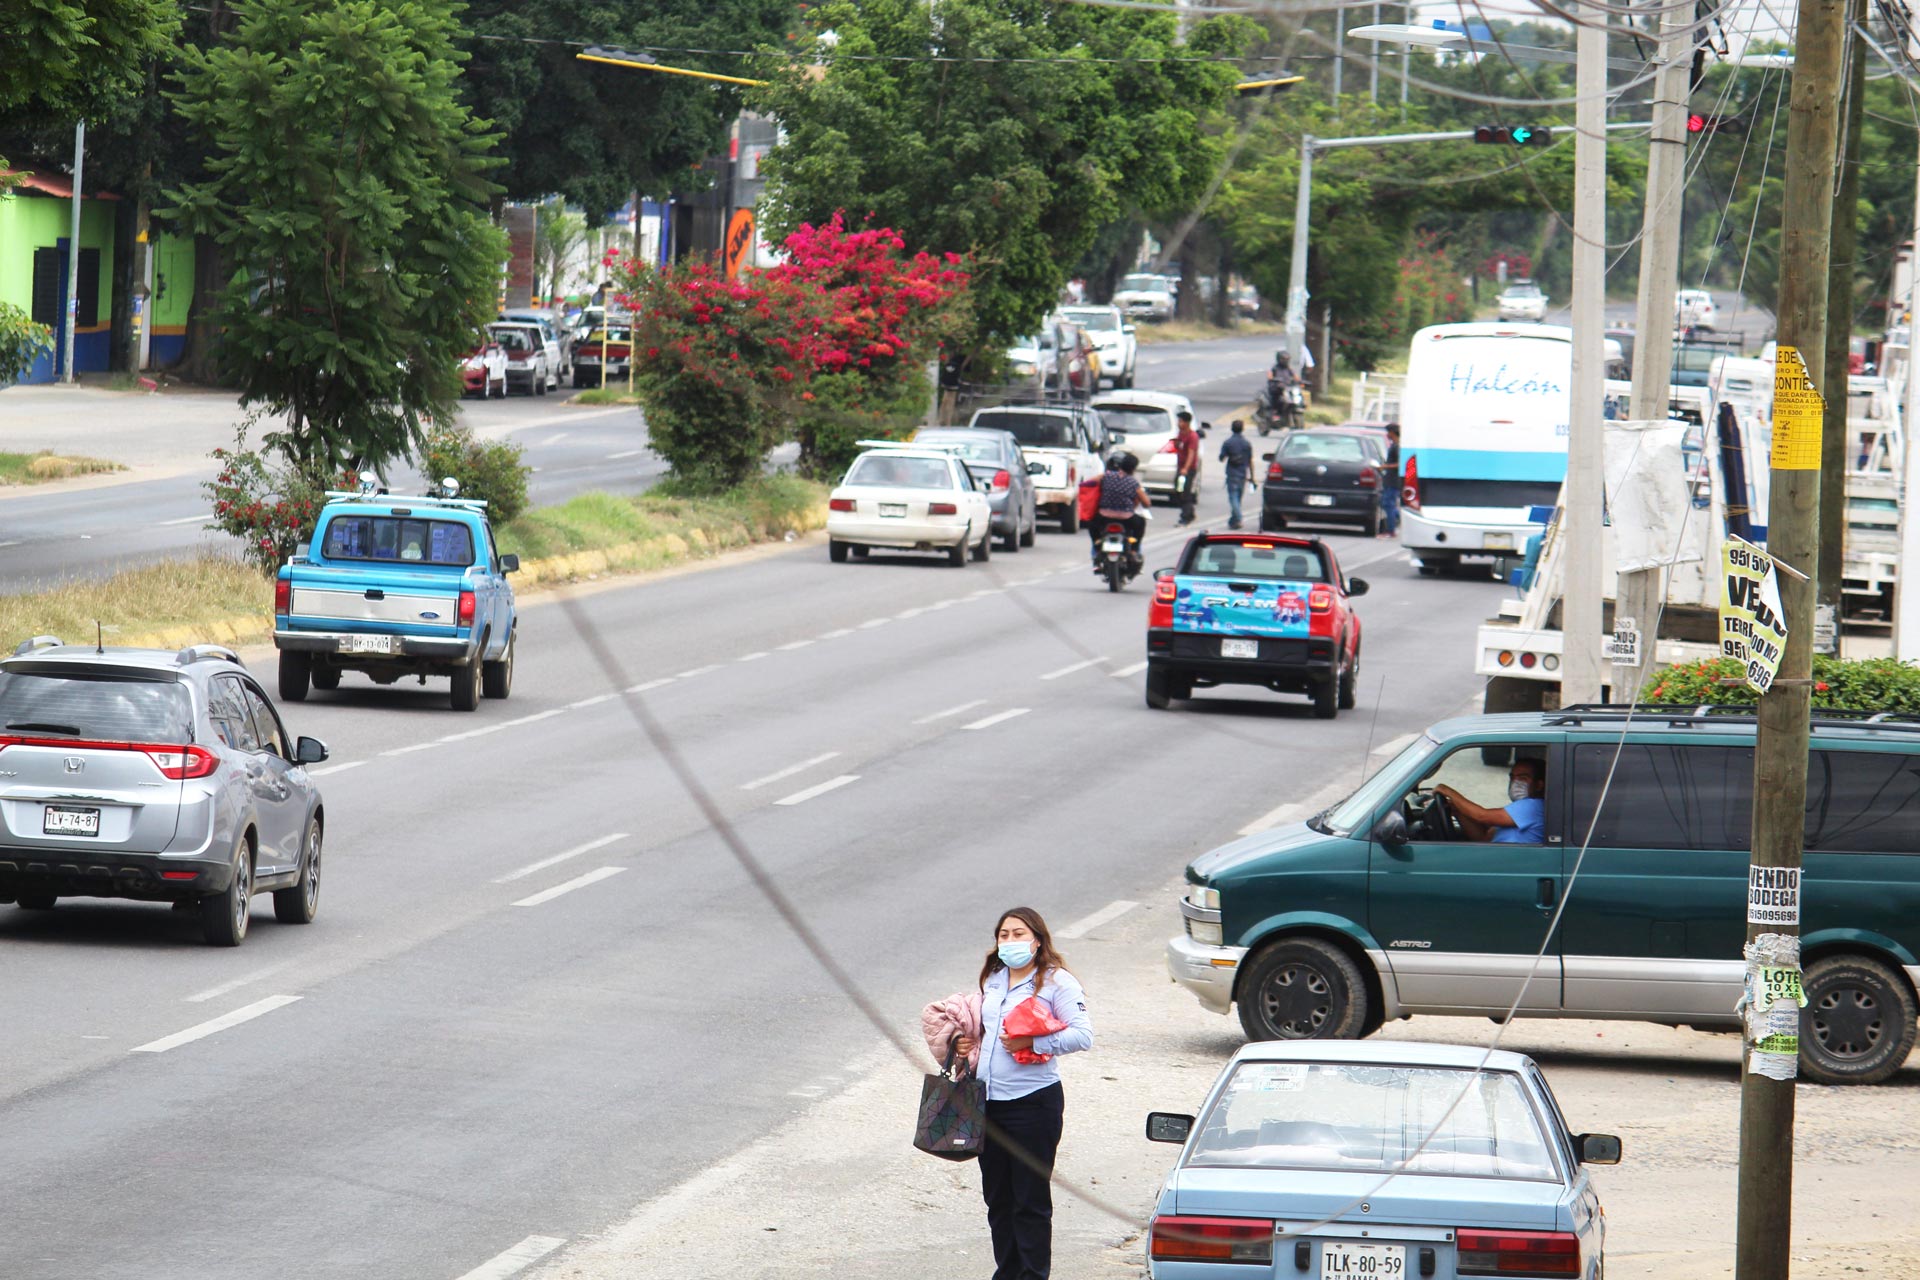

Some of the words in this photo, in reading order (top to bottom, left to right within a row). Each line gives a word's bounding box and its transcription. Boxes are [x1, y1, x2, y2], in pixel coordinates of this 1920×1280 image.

[729, 221, 751, 266] KTM
[1450, 363, 1562, 395] Halcón
[1775, 376, 1816, 391] CONTIE
[1730, 549, 1750, 568] 951
[47, 812, 98, 828] TLV-74-87
[1750, 867, 1798, 890] VENDO
[1750, 889, 1797, 907] BODEGA
[1749, 909, 1797, 921] 515095696
[1390, 940, 1432, 949] ASTRO
[1767, 984, 1781, 992] 10
[1325, 1252, 1402, 1275] TLK-80-59
